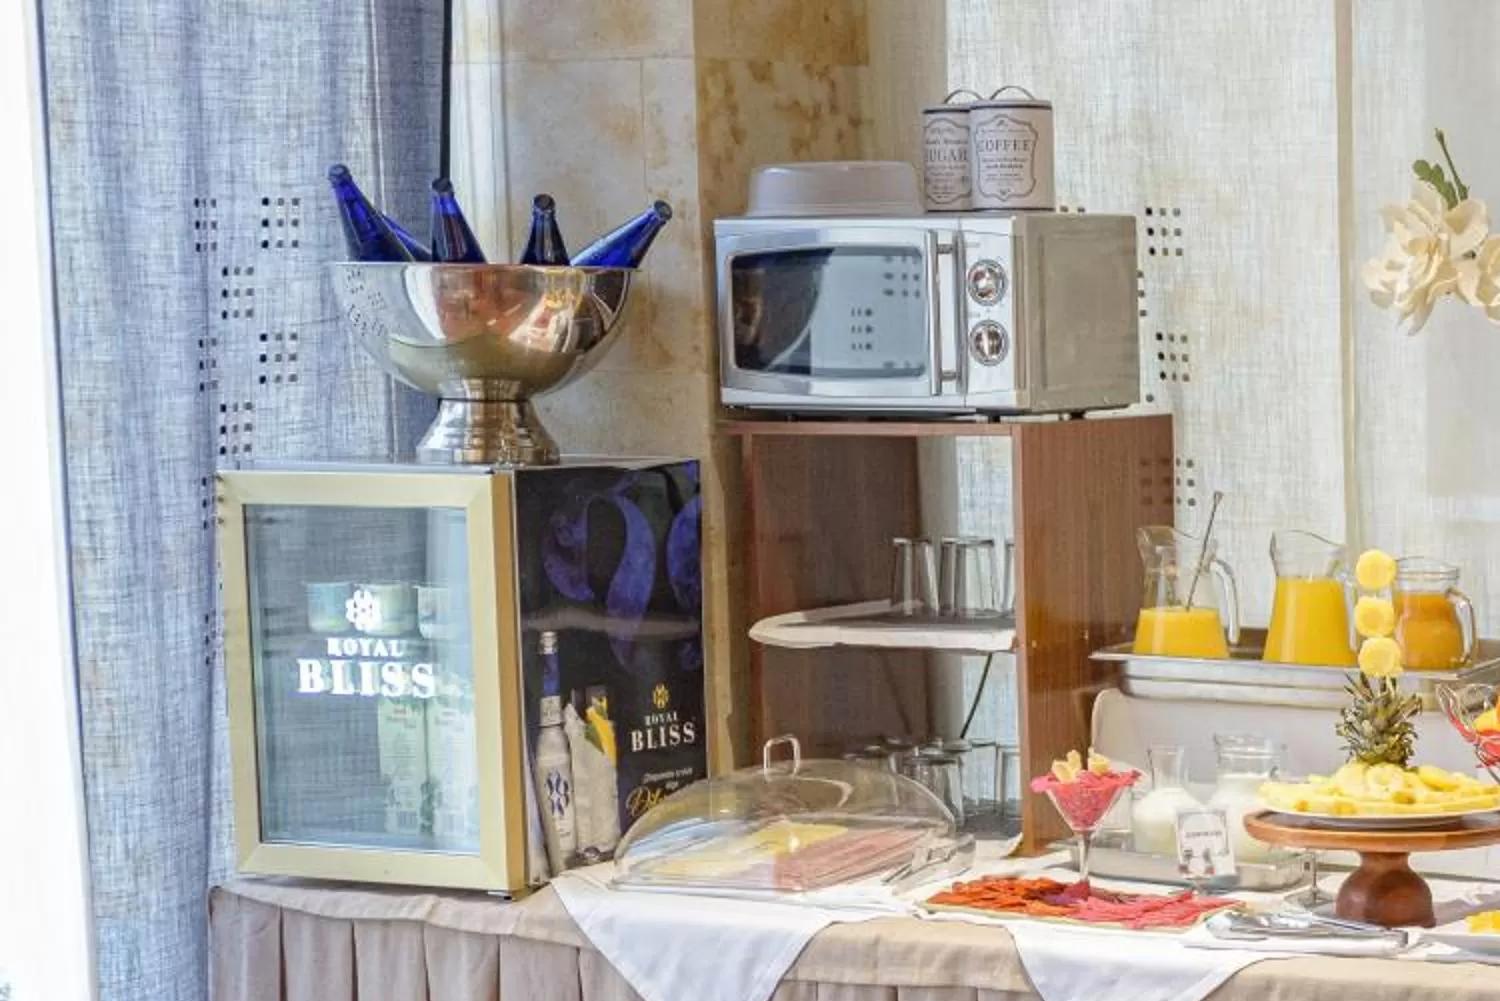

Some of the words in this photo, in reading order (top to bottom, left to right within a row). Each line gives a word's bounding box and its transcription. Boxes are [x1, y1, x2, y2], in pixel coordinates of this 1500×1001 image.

[976, 138, 1031, 152] COFFEE
[327, 637, 407, 656] ROYAL
[297, 658, 435, 698] BLISS
[644, 711, 678, 726] ROYAL
[630, 721, 695, 752] BLISS
